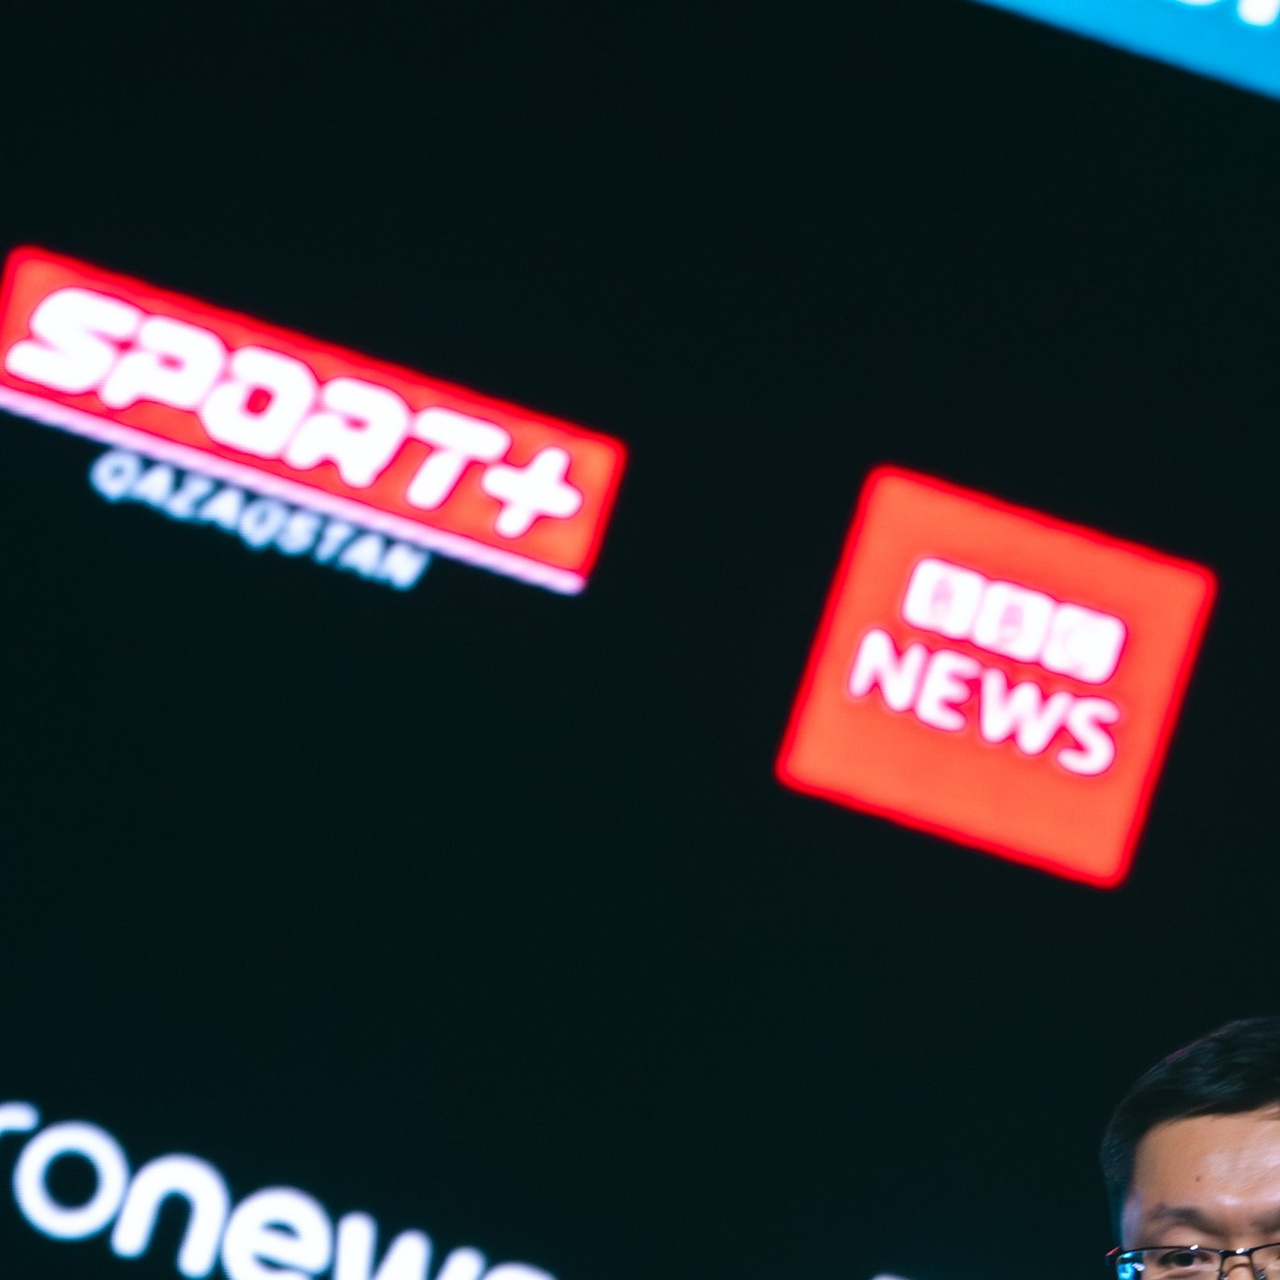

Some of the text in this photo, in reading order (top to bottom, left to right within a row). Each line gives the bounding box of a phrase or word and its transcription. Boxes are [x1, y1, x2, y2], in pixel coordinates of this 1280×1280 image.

[5, 286, 583, 538] SPORT+
[90, 446, 432, 591] QAZAQSTAN
[848, 627, 1122, 776] NEWS
